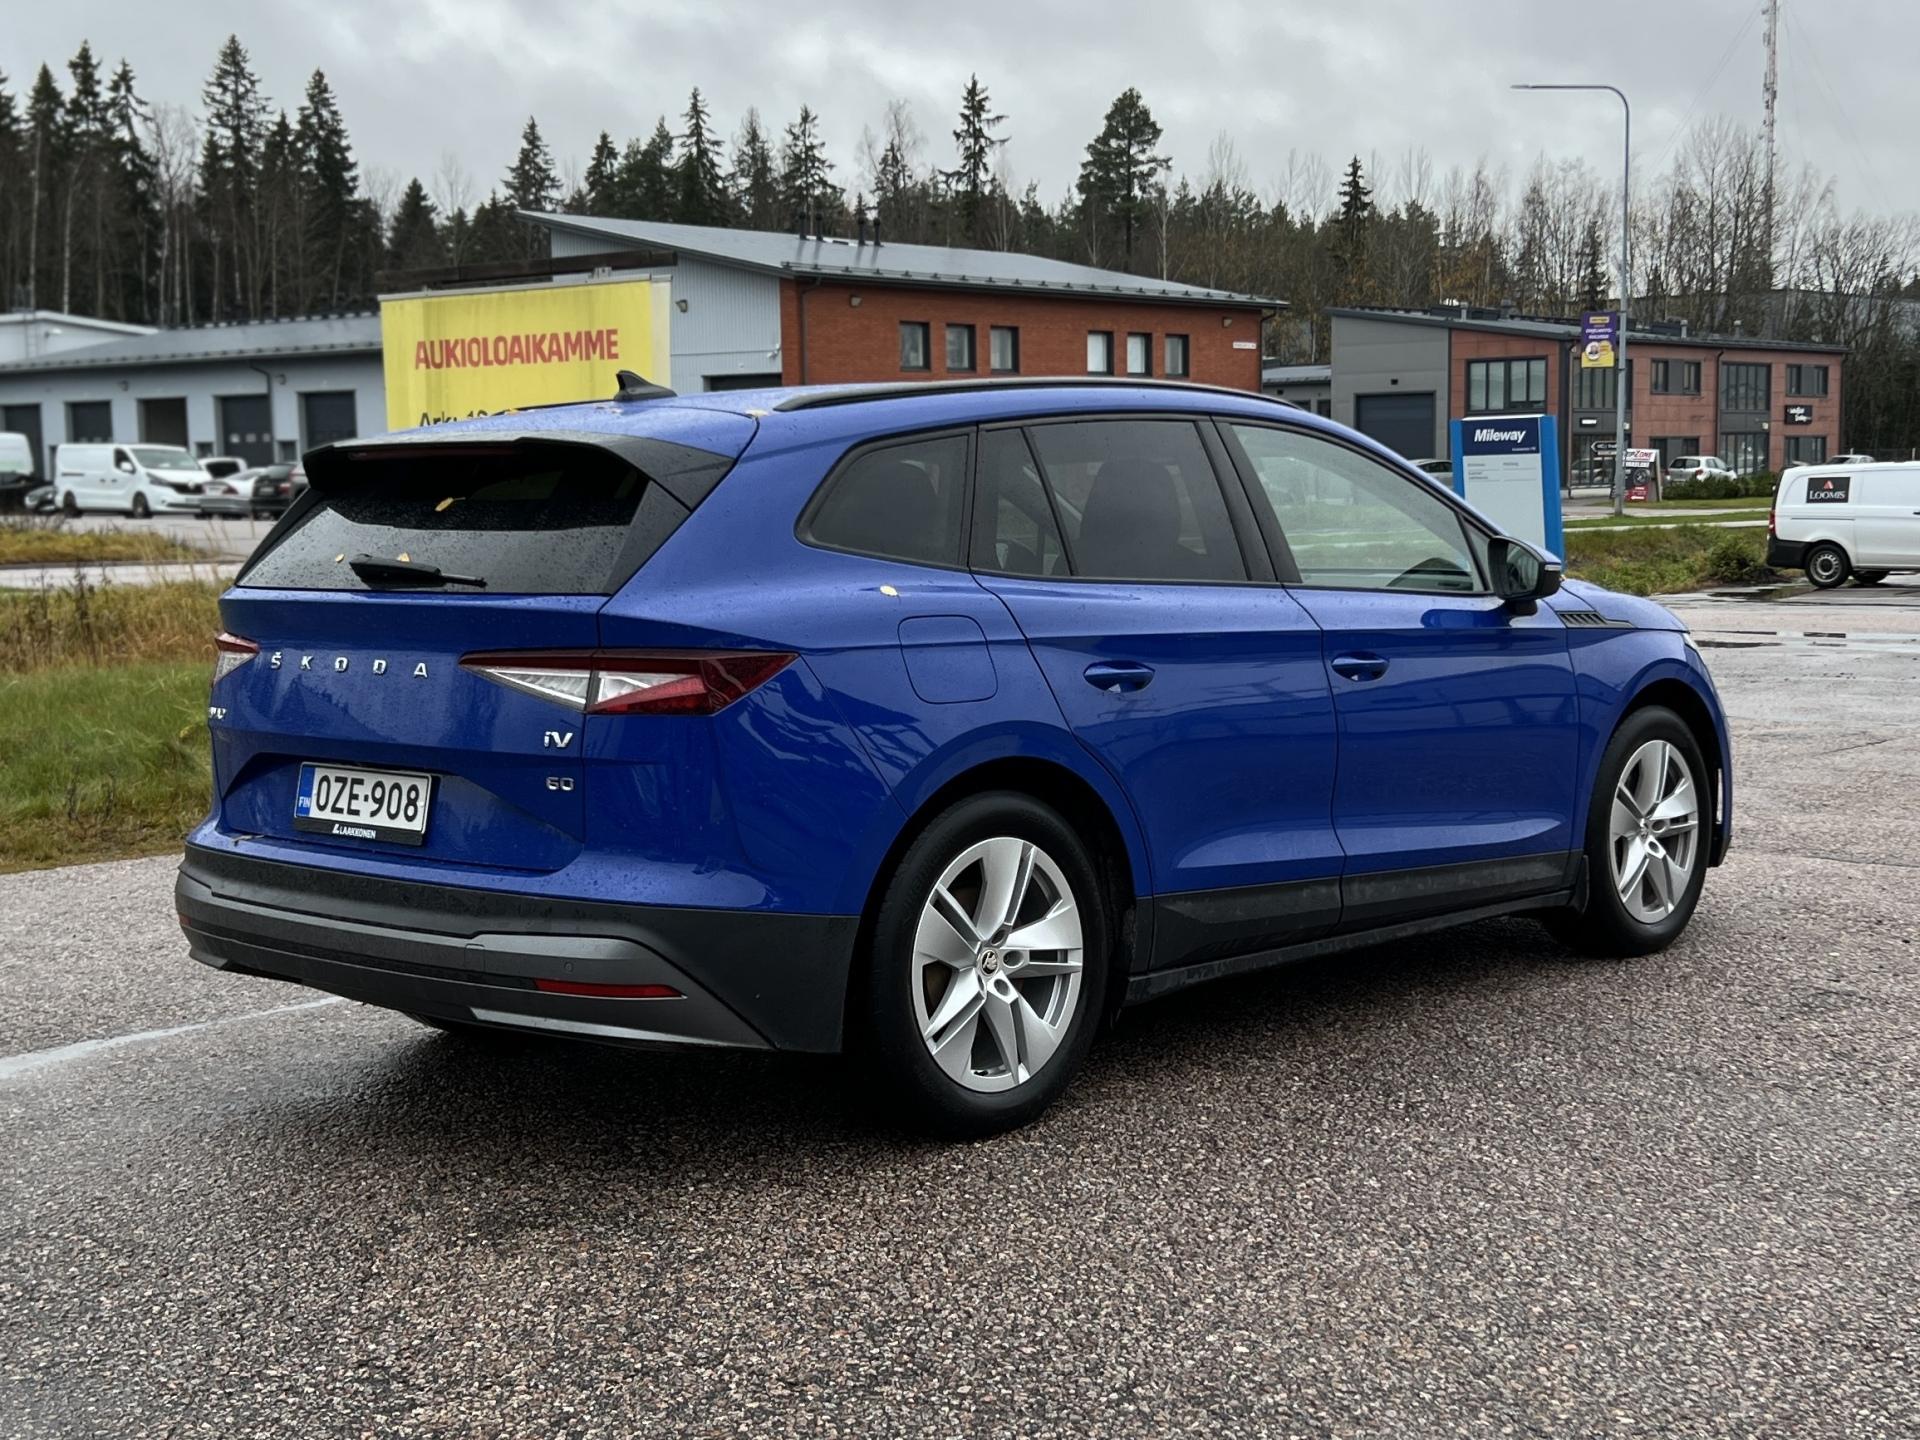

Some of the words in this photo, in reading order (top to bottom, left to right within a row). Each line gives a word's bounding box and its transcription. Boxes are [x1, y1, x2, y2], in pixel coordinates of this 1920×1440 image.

[415, 328, 619, 370] AUKIOLOAIKAMME
[1474, 428, 1526, 444] Mileway
[1809, 490, 1847, 500] LOOMIS
[270, 651, 429, 679] ŠKODA
[544, 731, 574, 748] iV
[546, 776, 575, 791] 60
[298, 796, 312, 809] FIN
[315, 774, 420, 823] OZE-908
[339, 826, 377, 840] LAAKKONEN
